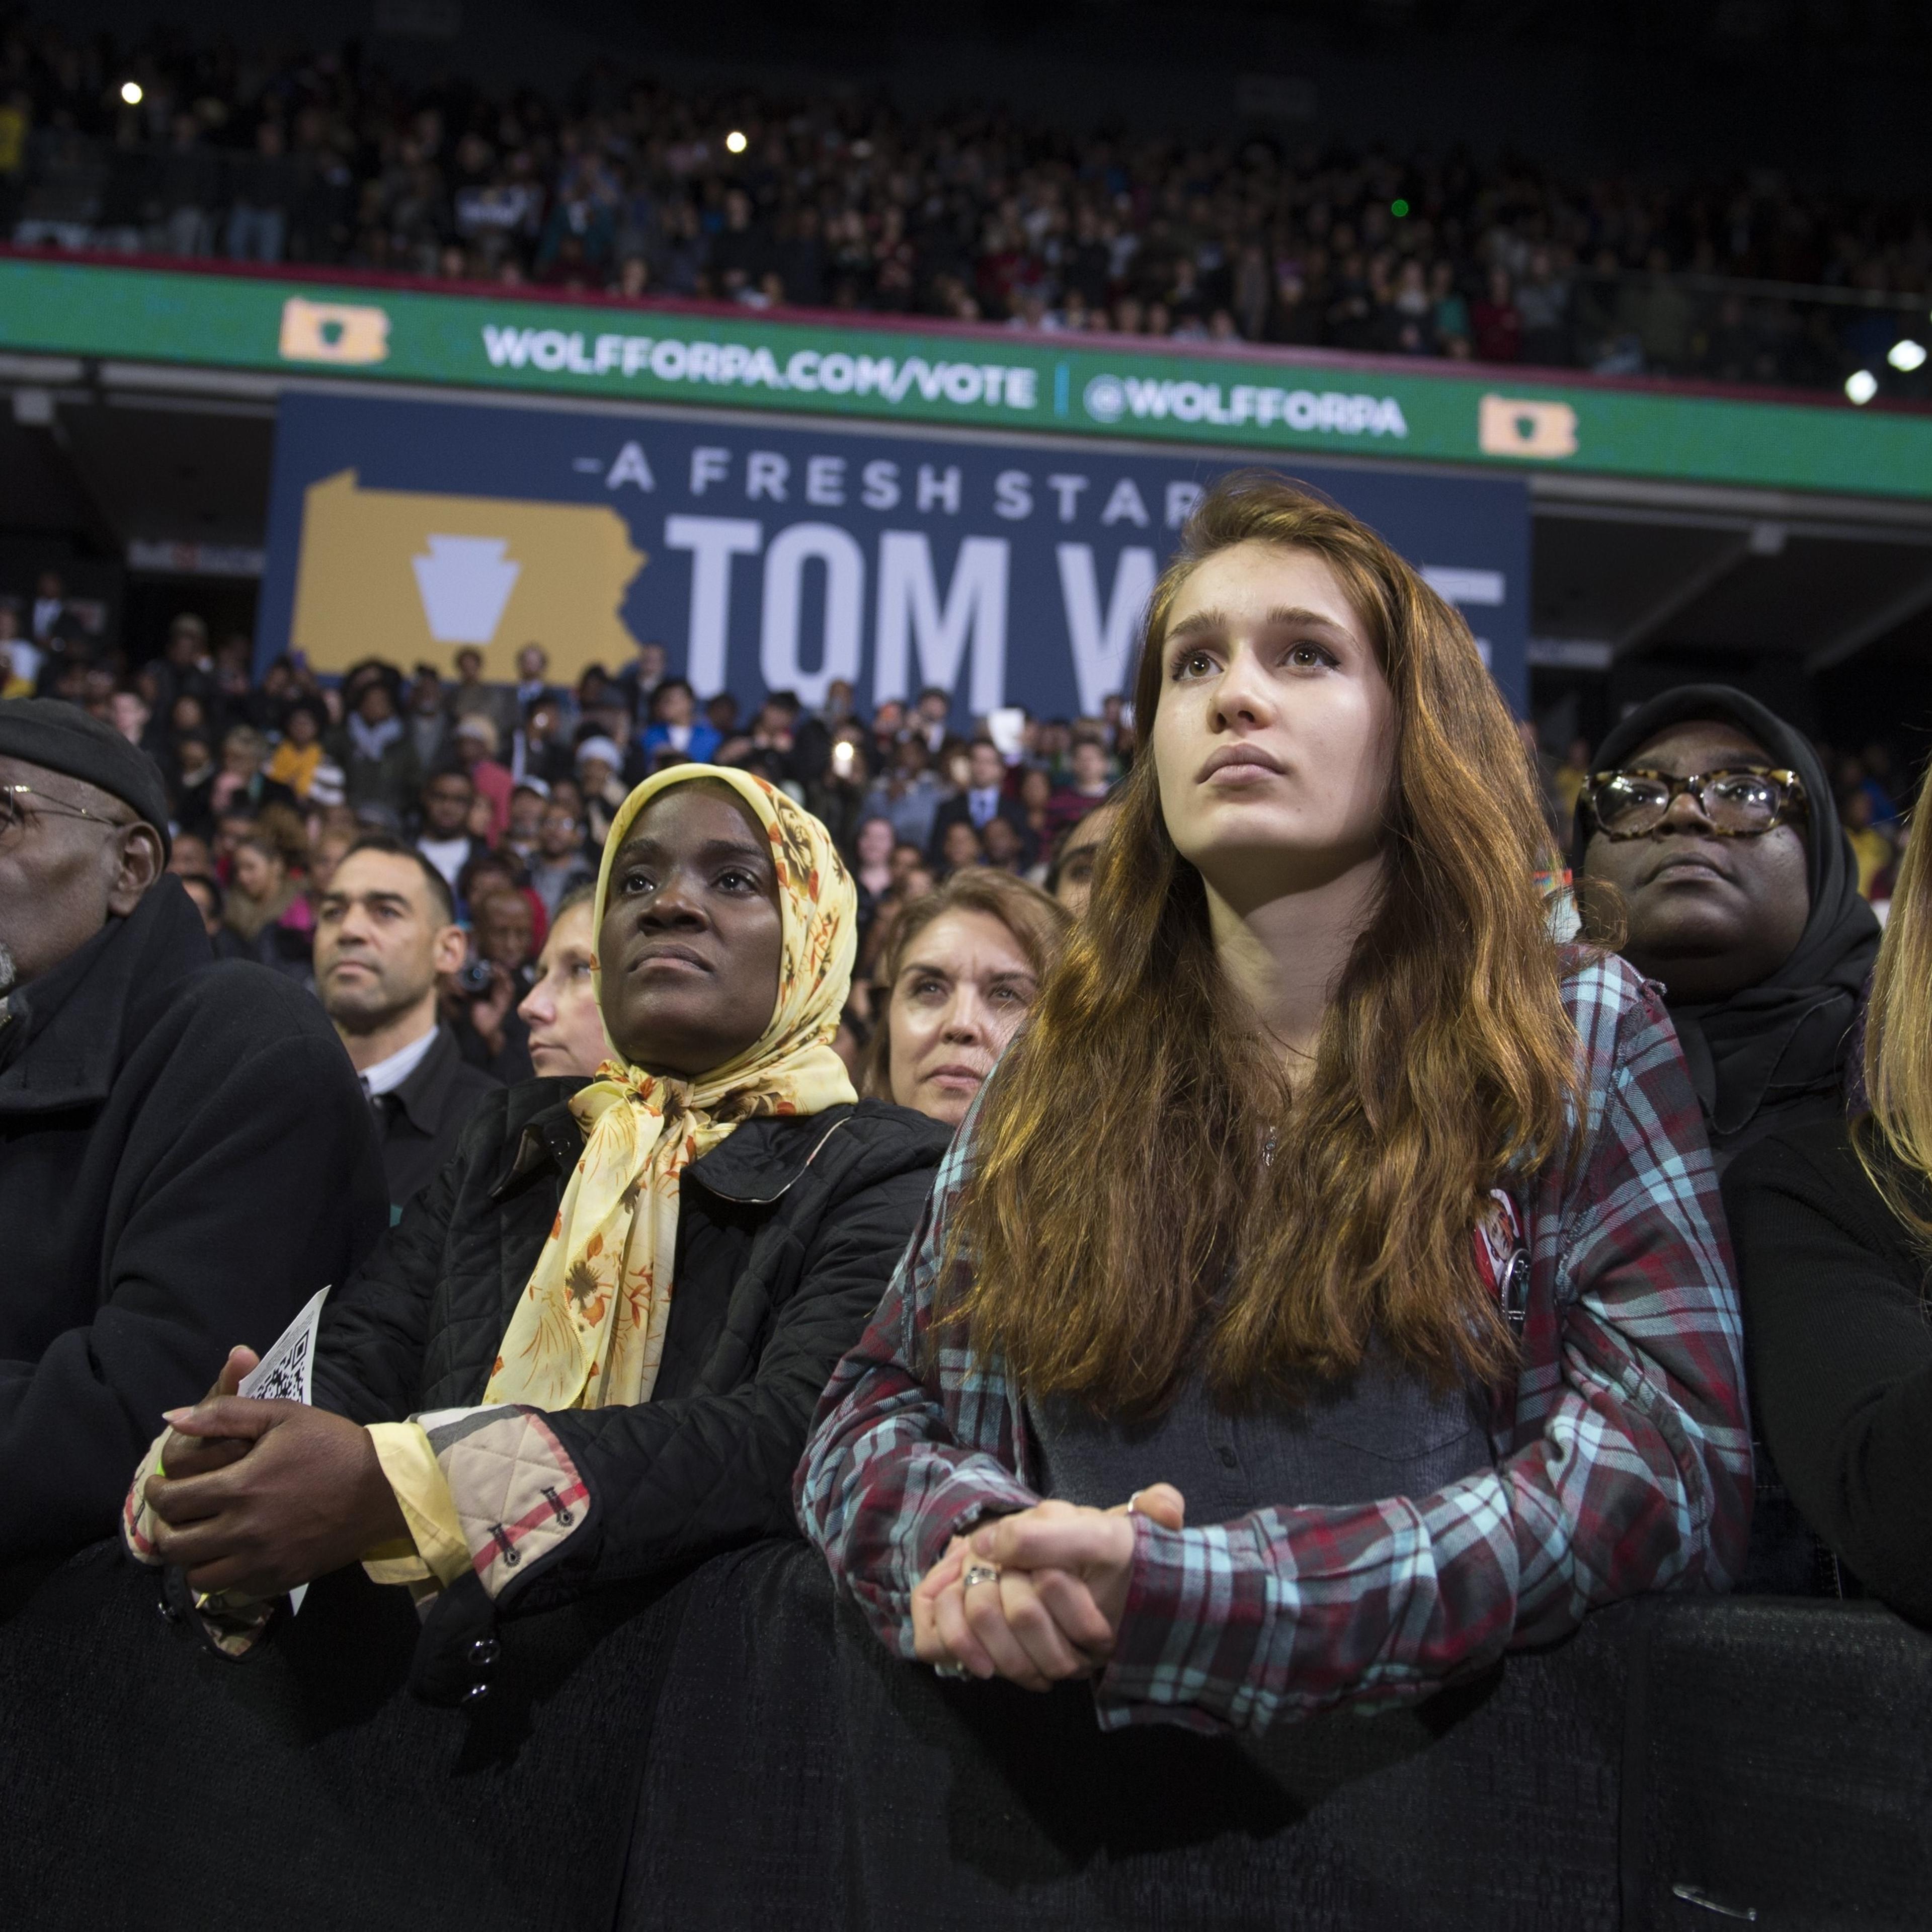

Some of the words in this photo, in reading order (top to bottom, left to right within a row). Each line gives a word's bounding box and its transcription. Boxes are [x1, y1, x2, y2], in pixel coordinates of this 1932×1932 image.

[484, 325, 1037, 410] WOLFFORPA.COM/VOTE
[1083, 373, 1407, 438] @WOLFFORPA
[689, 447, 961, 513] FRESH
[995, 469, 1208, 529] STAR
[665, 514, 1010, 715] TOM
